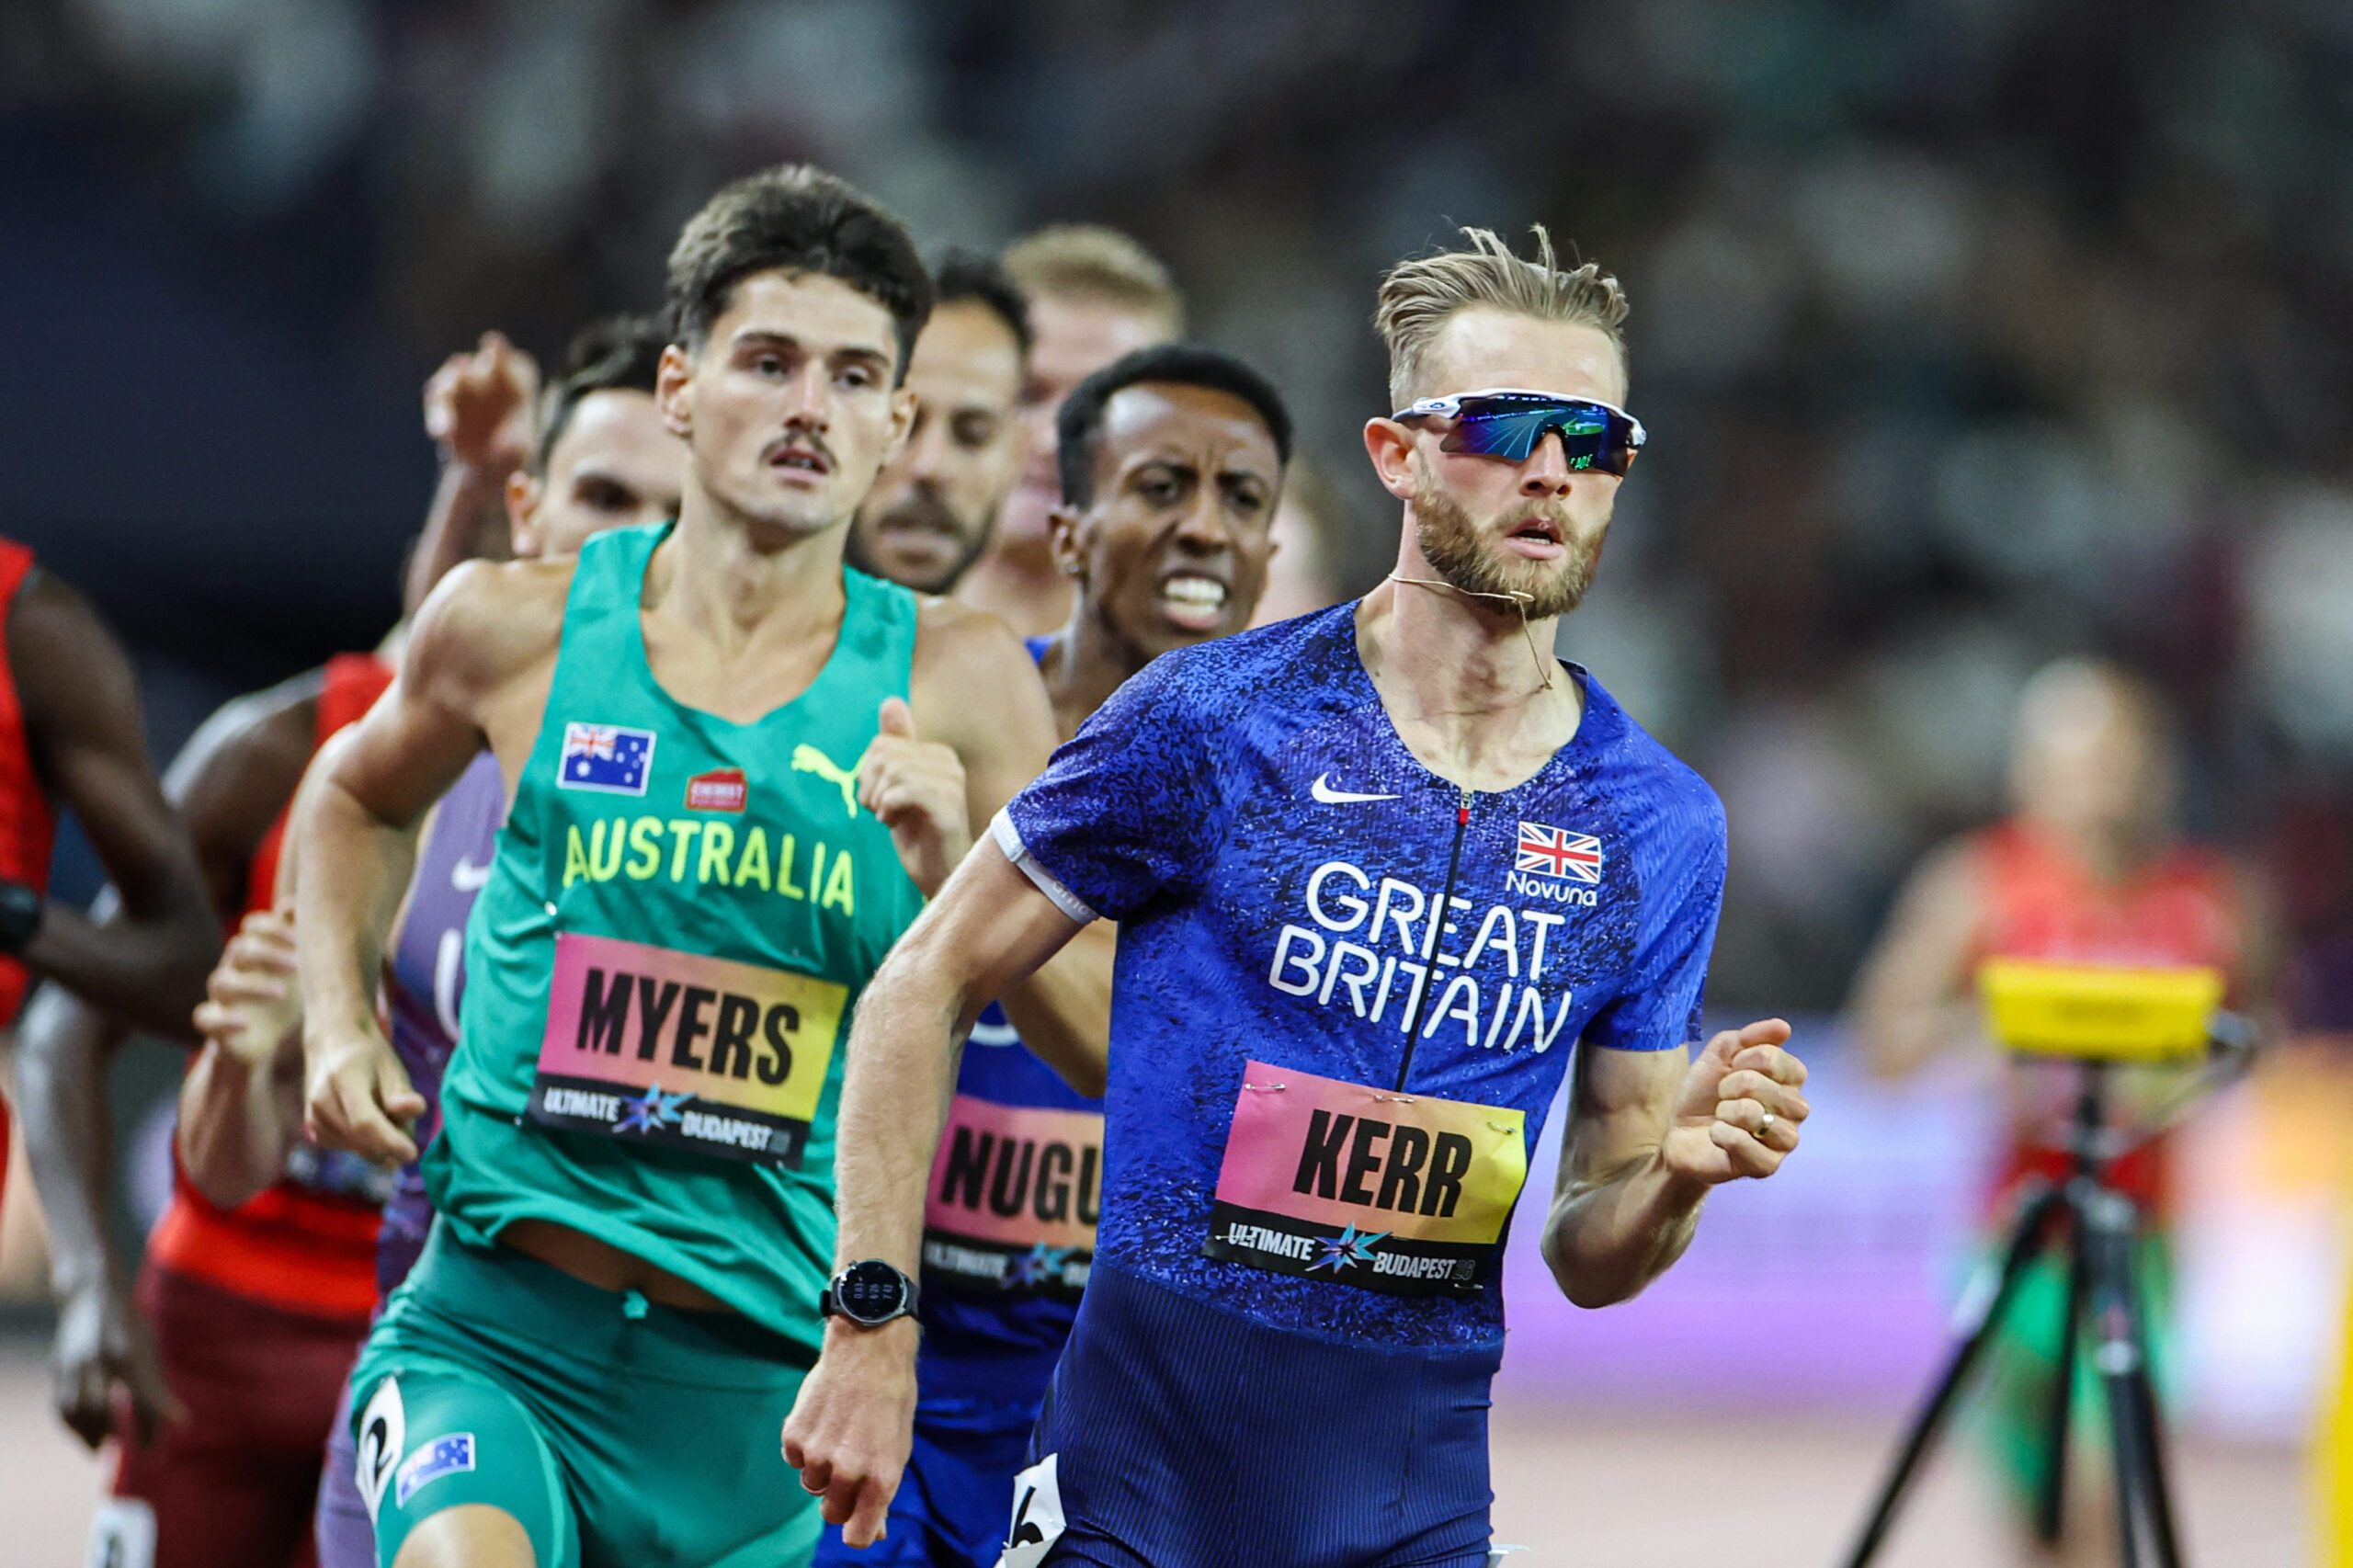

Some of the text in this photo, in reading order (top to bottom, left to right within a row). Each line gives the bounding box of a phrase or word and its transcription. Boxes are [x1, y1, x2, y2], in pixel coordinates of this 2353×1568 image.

[562, 815, 855, 917] AUSTRALIA
[1505, 869, 1597, 906] Novuna
[1305, 860, 1566, 982] GREAT
[575, 968, 801, 1086] MYERS
[1268, 924, 1573, 1054] BRITAIN
[1292, 1108, 1473, 1219] KERR
[1227, 1221, 1316, 1262] ULTIMATE
[1371, 1251, 1458, 1280] BUDAPEST
[366, 1415, 393, 1489] 2
